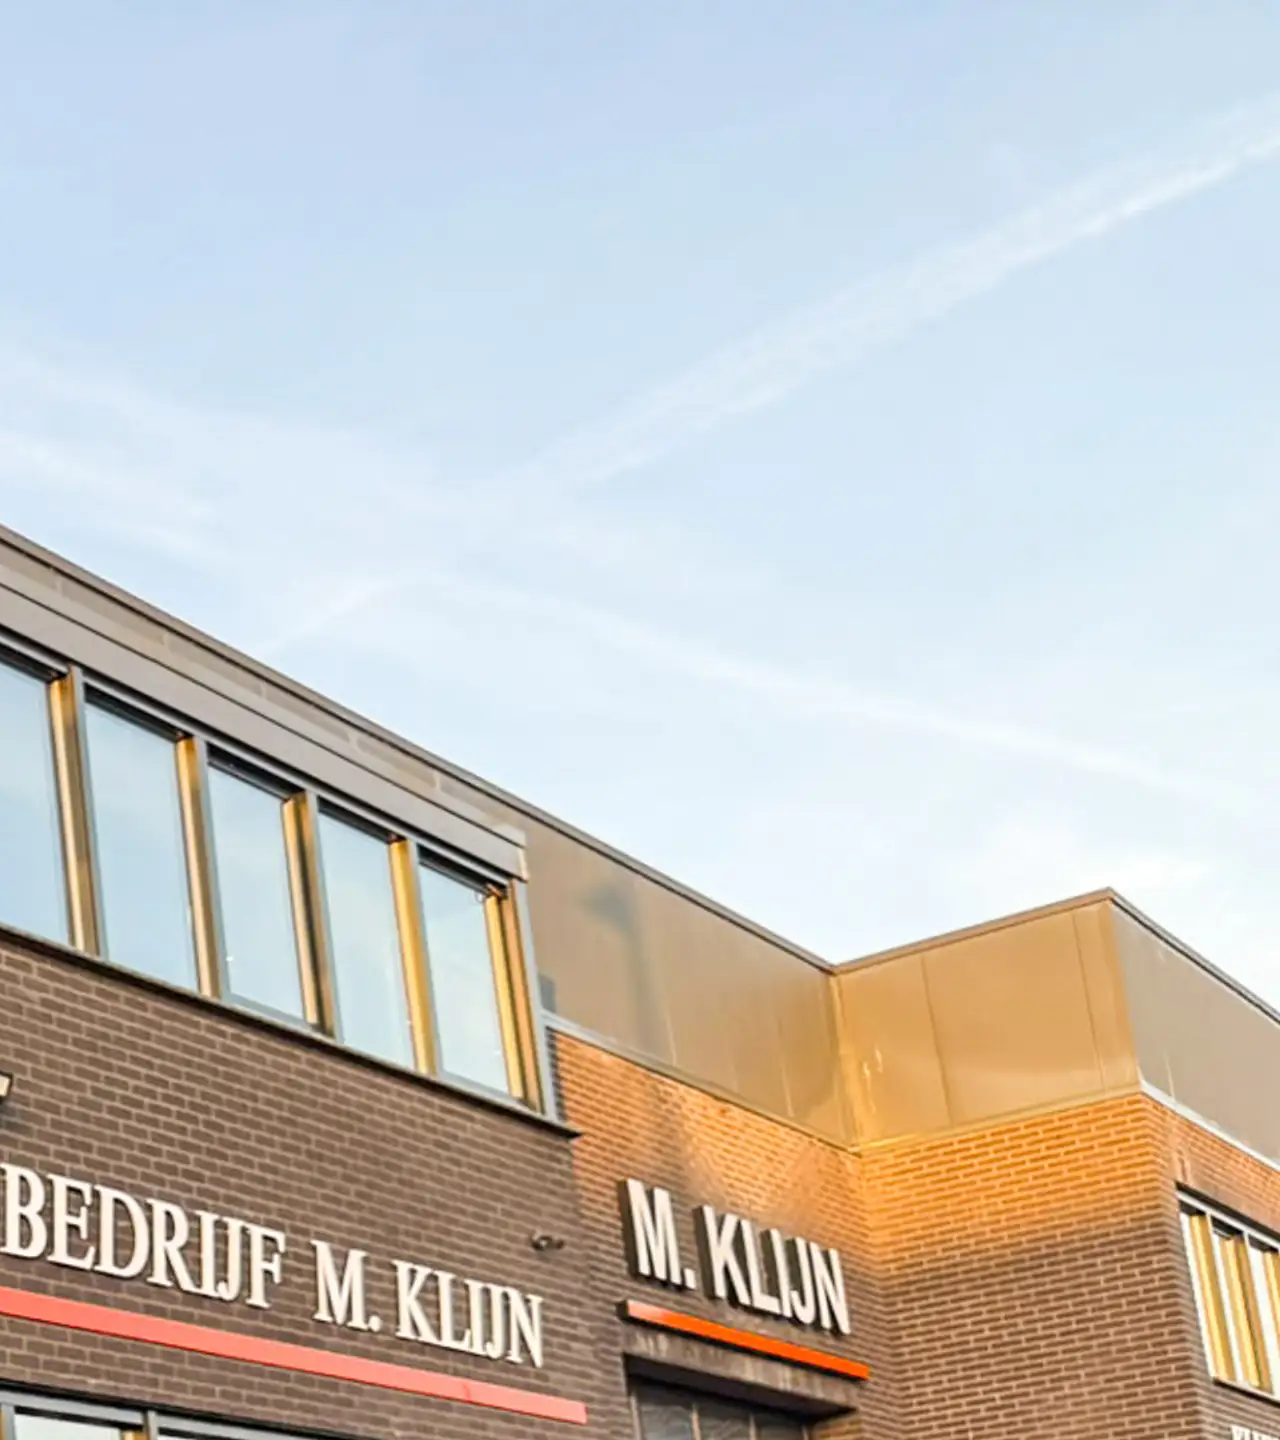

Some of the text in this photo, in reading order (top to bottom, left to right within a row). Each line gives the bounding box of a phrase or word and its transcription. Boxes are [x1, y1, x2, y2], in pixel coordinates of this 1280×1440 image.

[310, 1240, 383, 1332] M.
[391, 1259, 543, 1368] KLIJN
[622, 1178, 851, 1335] M. KLIJN
